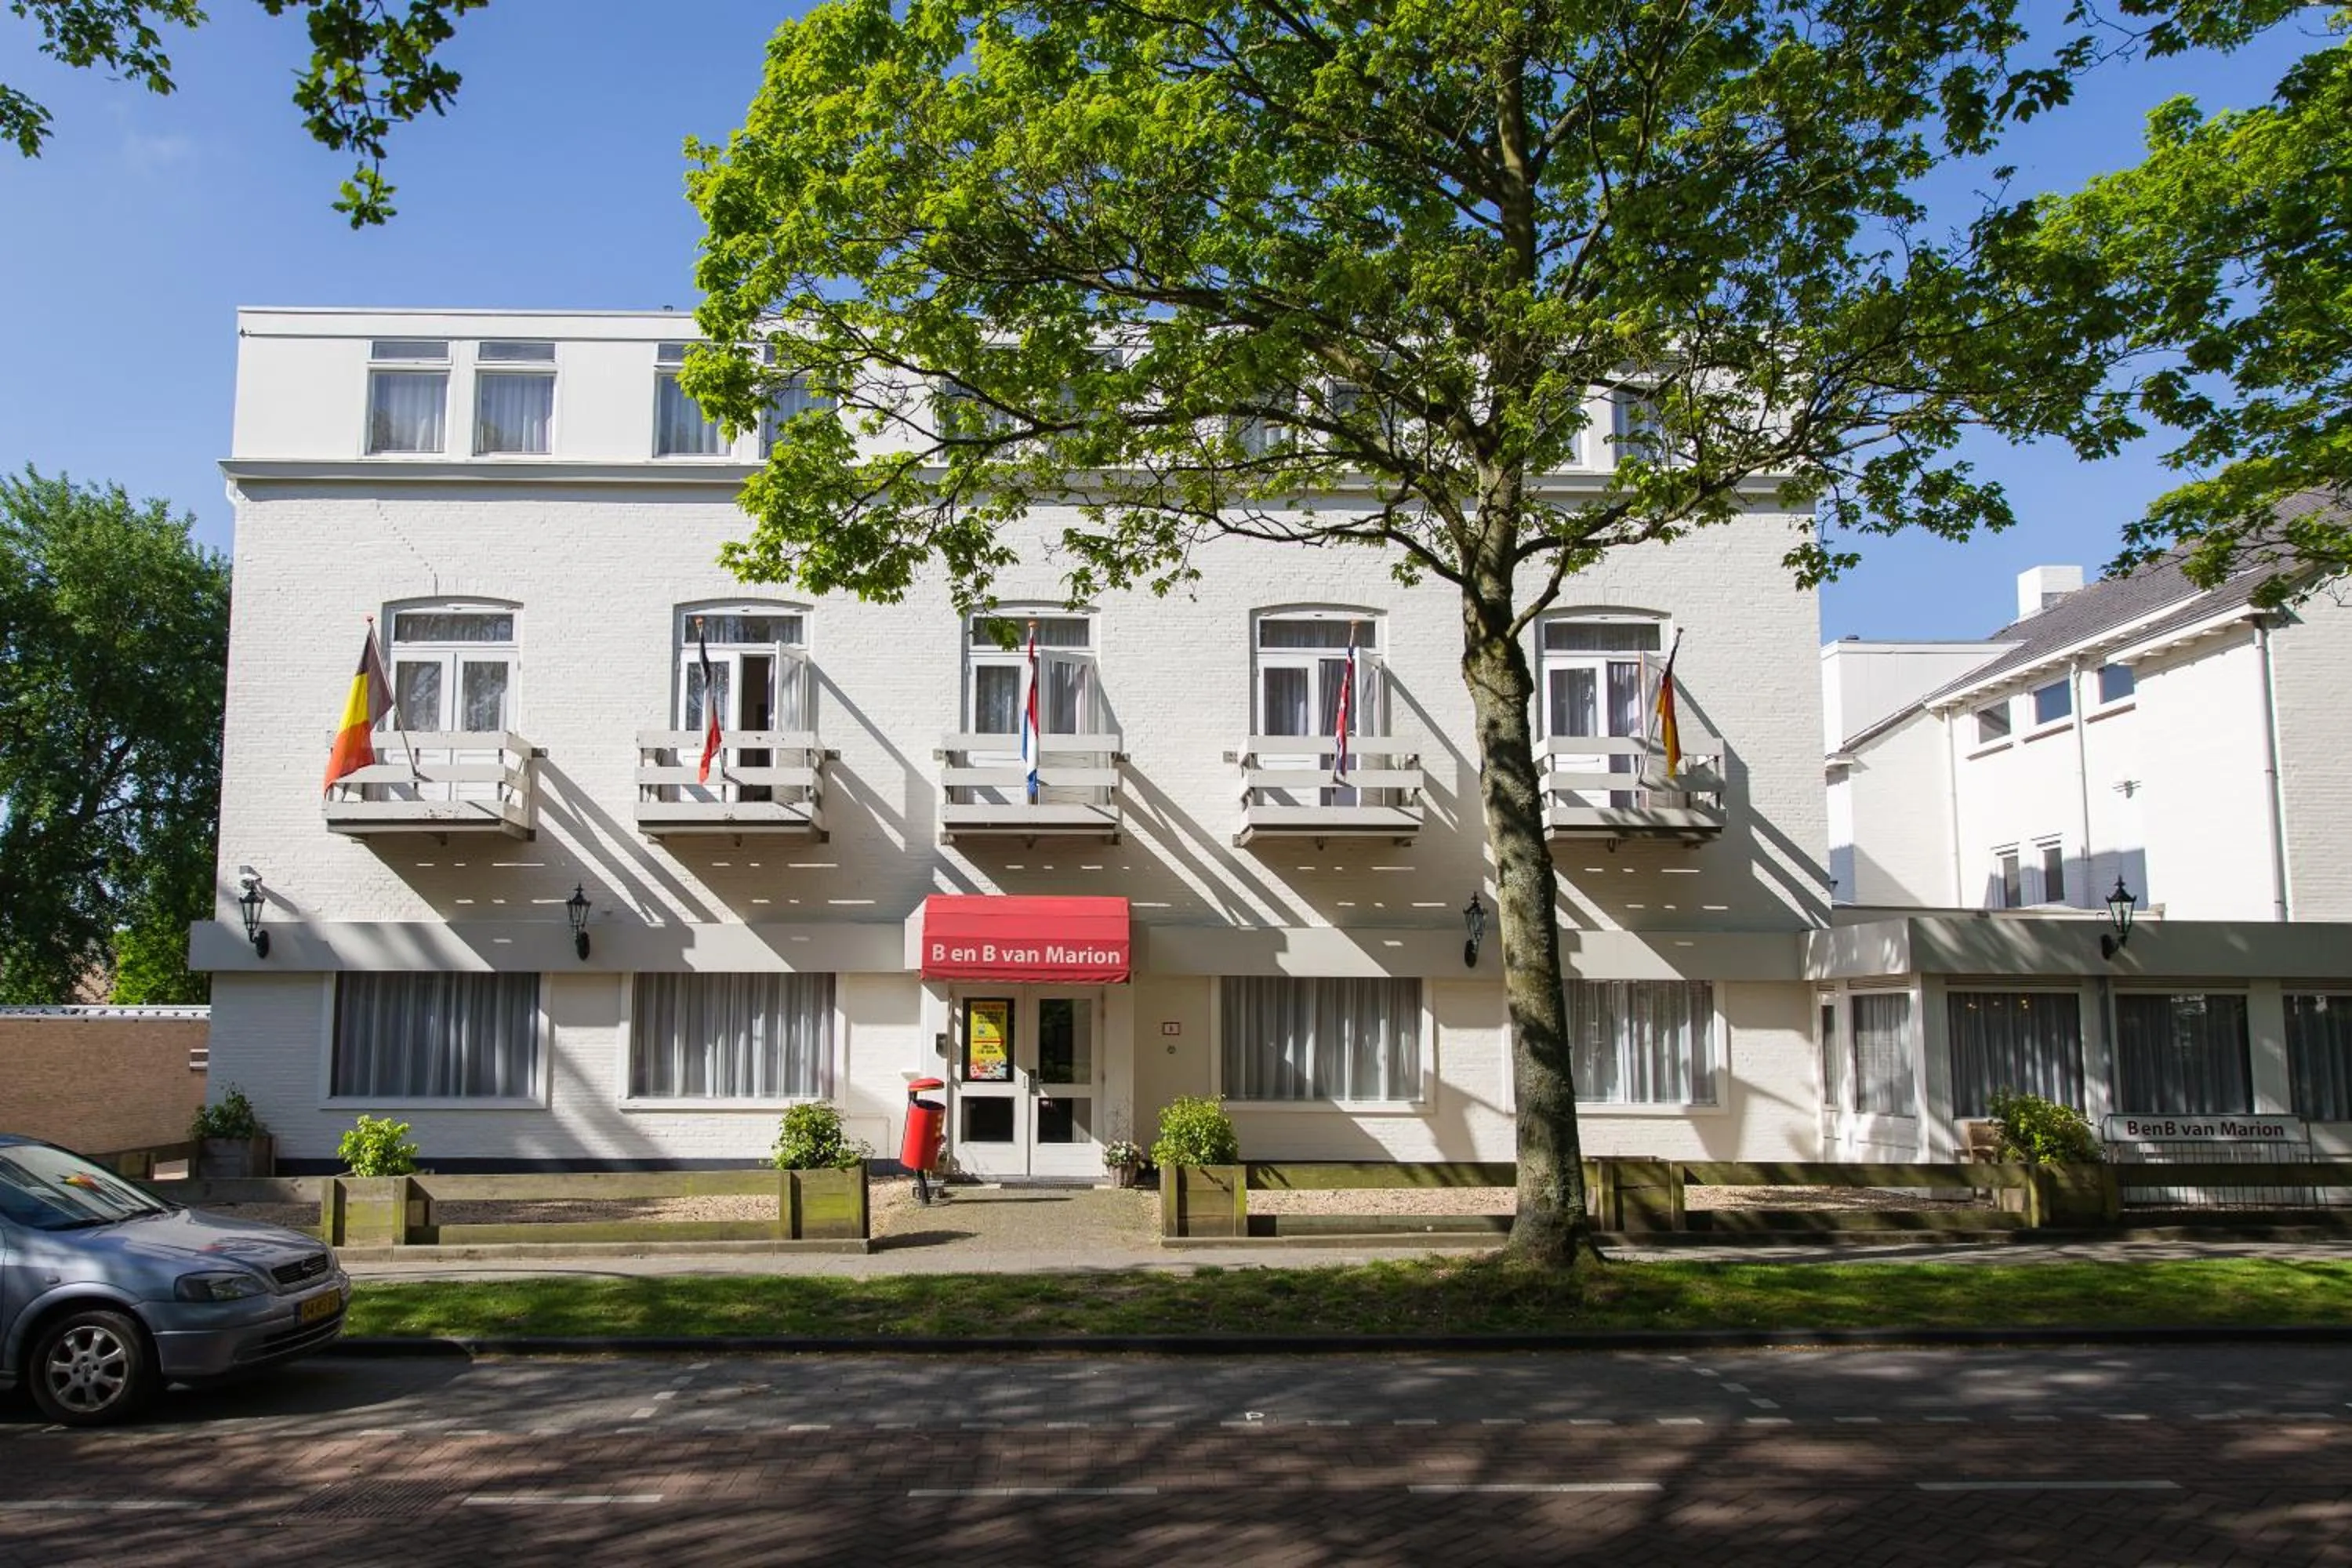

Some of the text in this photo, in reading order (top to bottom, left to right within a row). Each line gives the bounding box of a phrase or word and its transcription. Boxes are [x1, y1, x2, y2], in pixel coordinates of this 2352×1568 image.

[951, 947, 976, 962] en
[1001, 949, 1039, 963] van
[1045, 946, 1120, 964] Marion
[2181, 1123, 2214, 1136] van
[2220, 1121, 2284, 1137] Marion
